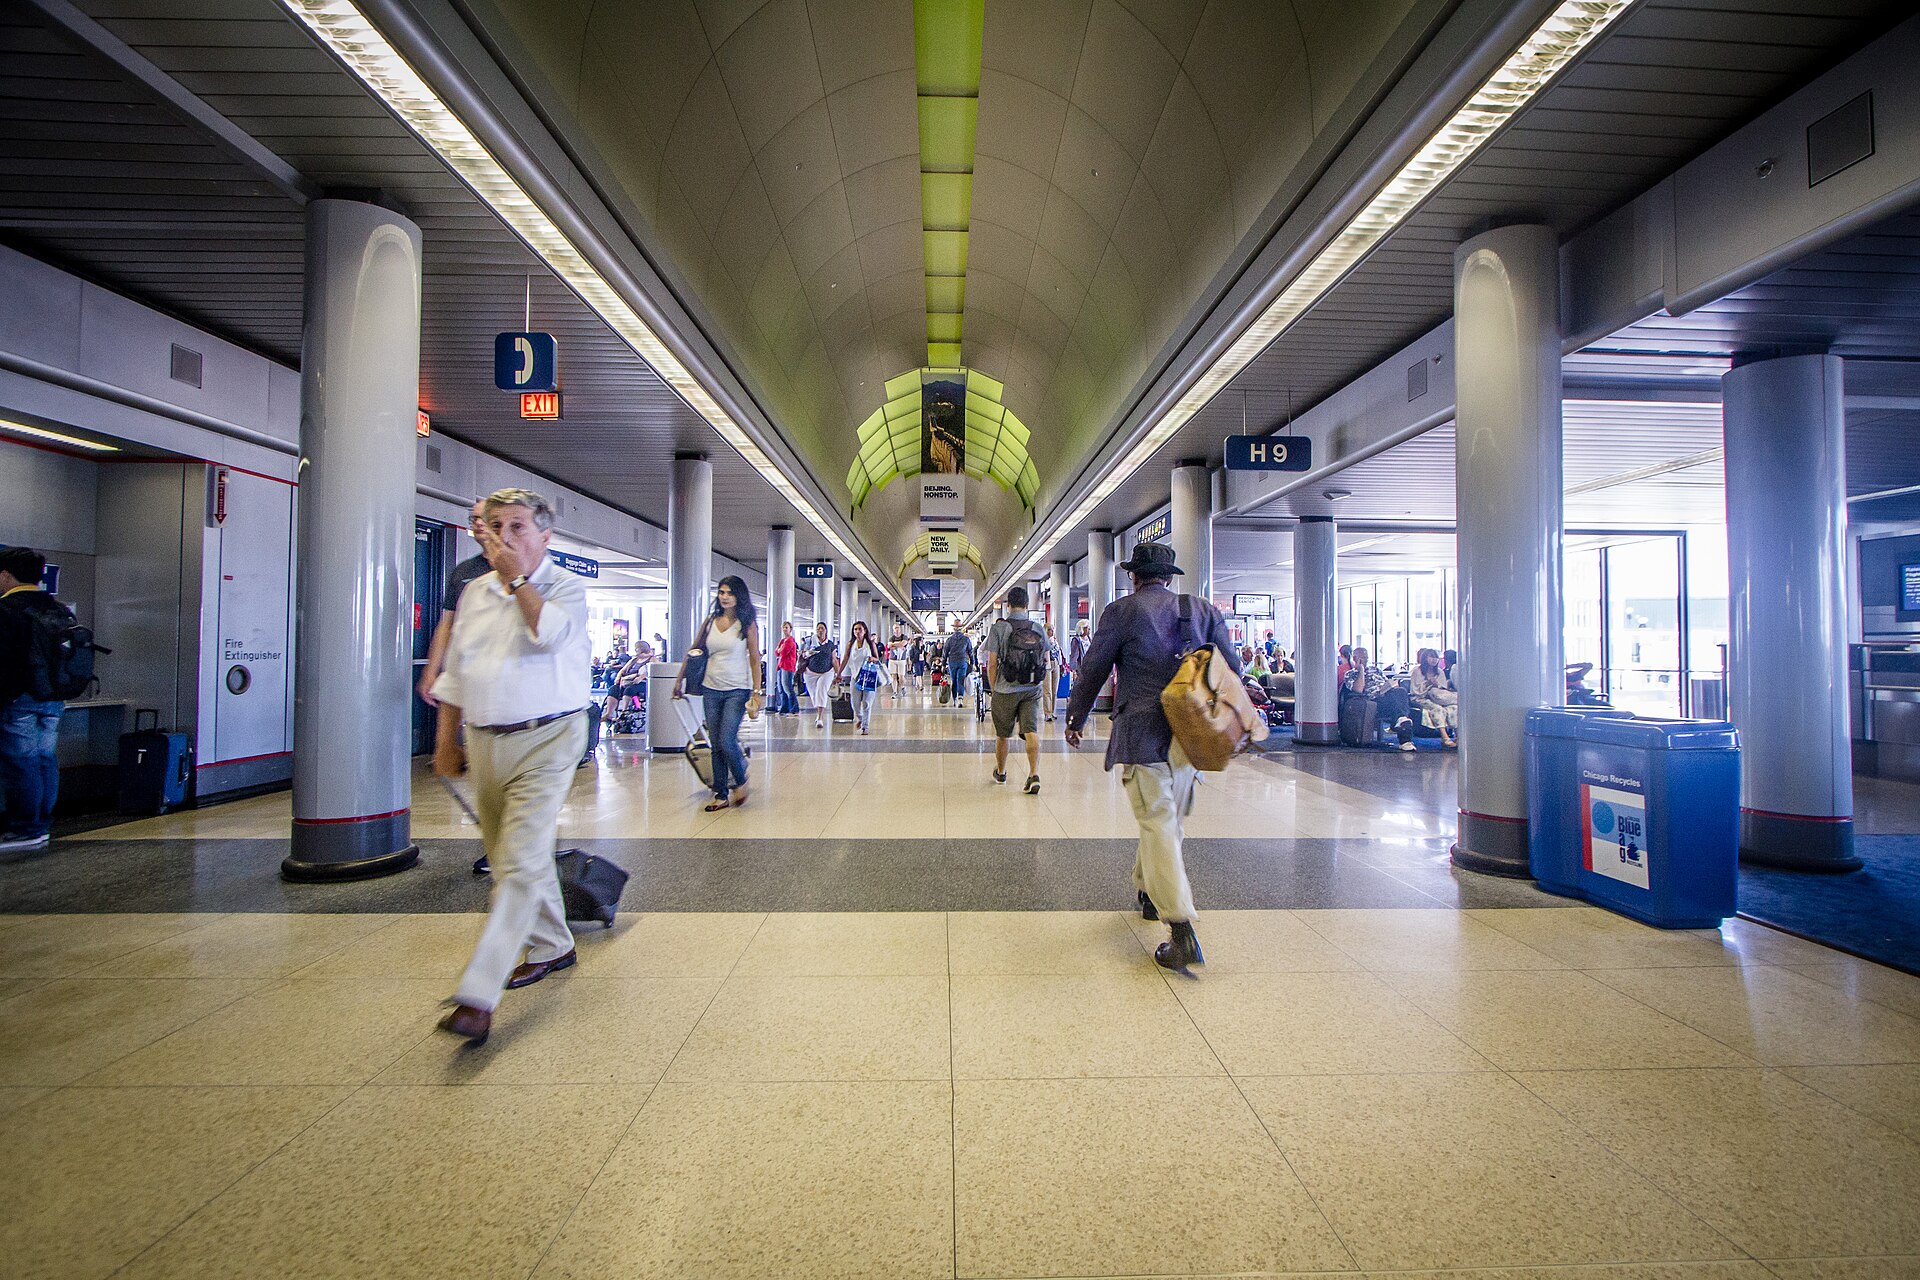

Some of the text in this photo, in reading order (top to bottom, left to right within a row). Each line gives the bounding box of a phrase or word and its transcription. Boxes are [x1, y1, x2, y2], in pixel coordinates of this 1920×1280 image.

[523, 394, 556, 412] EXIT
[1250, 443, 1288, 463] H 9
[806, 566, 825, 576] H 8
[225, 638, 243, 648] Fire
[225, 650, 281, 661] Extinguisher
[1583, 770, 1641, 787] Chicago Recycles
[1618, 815, 1641, 837] Blue
